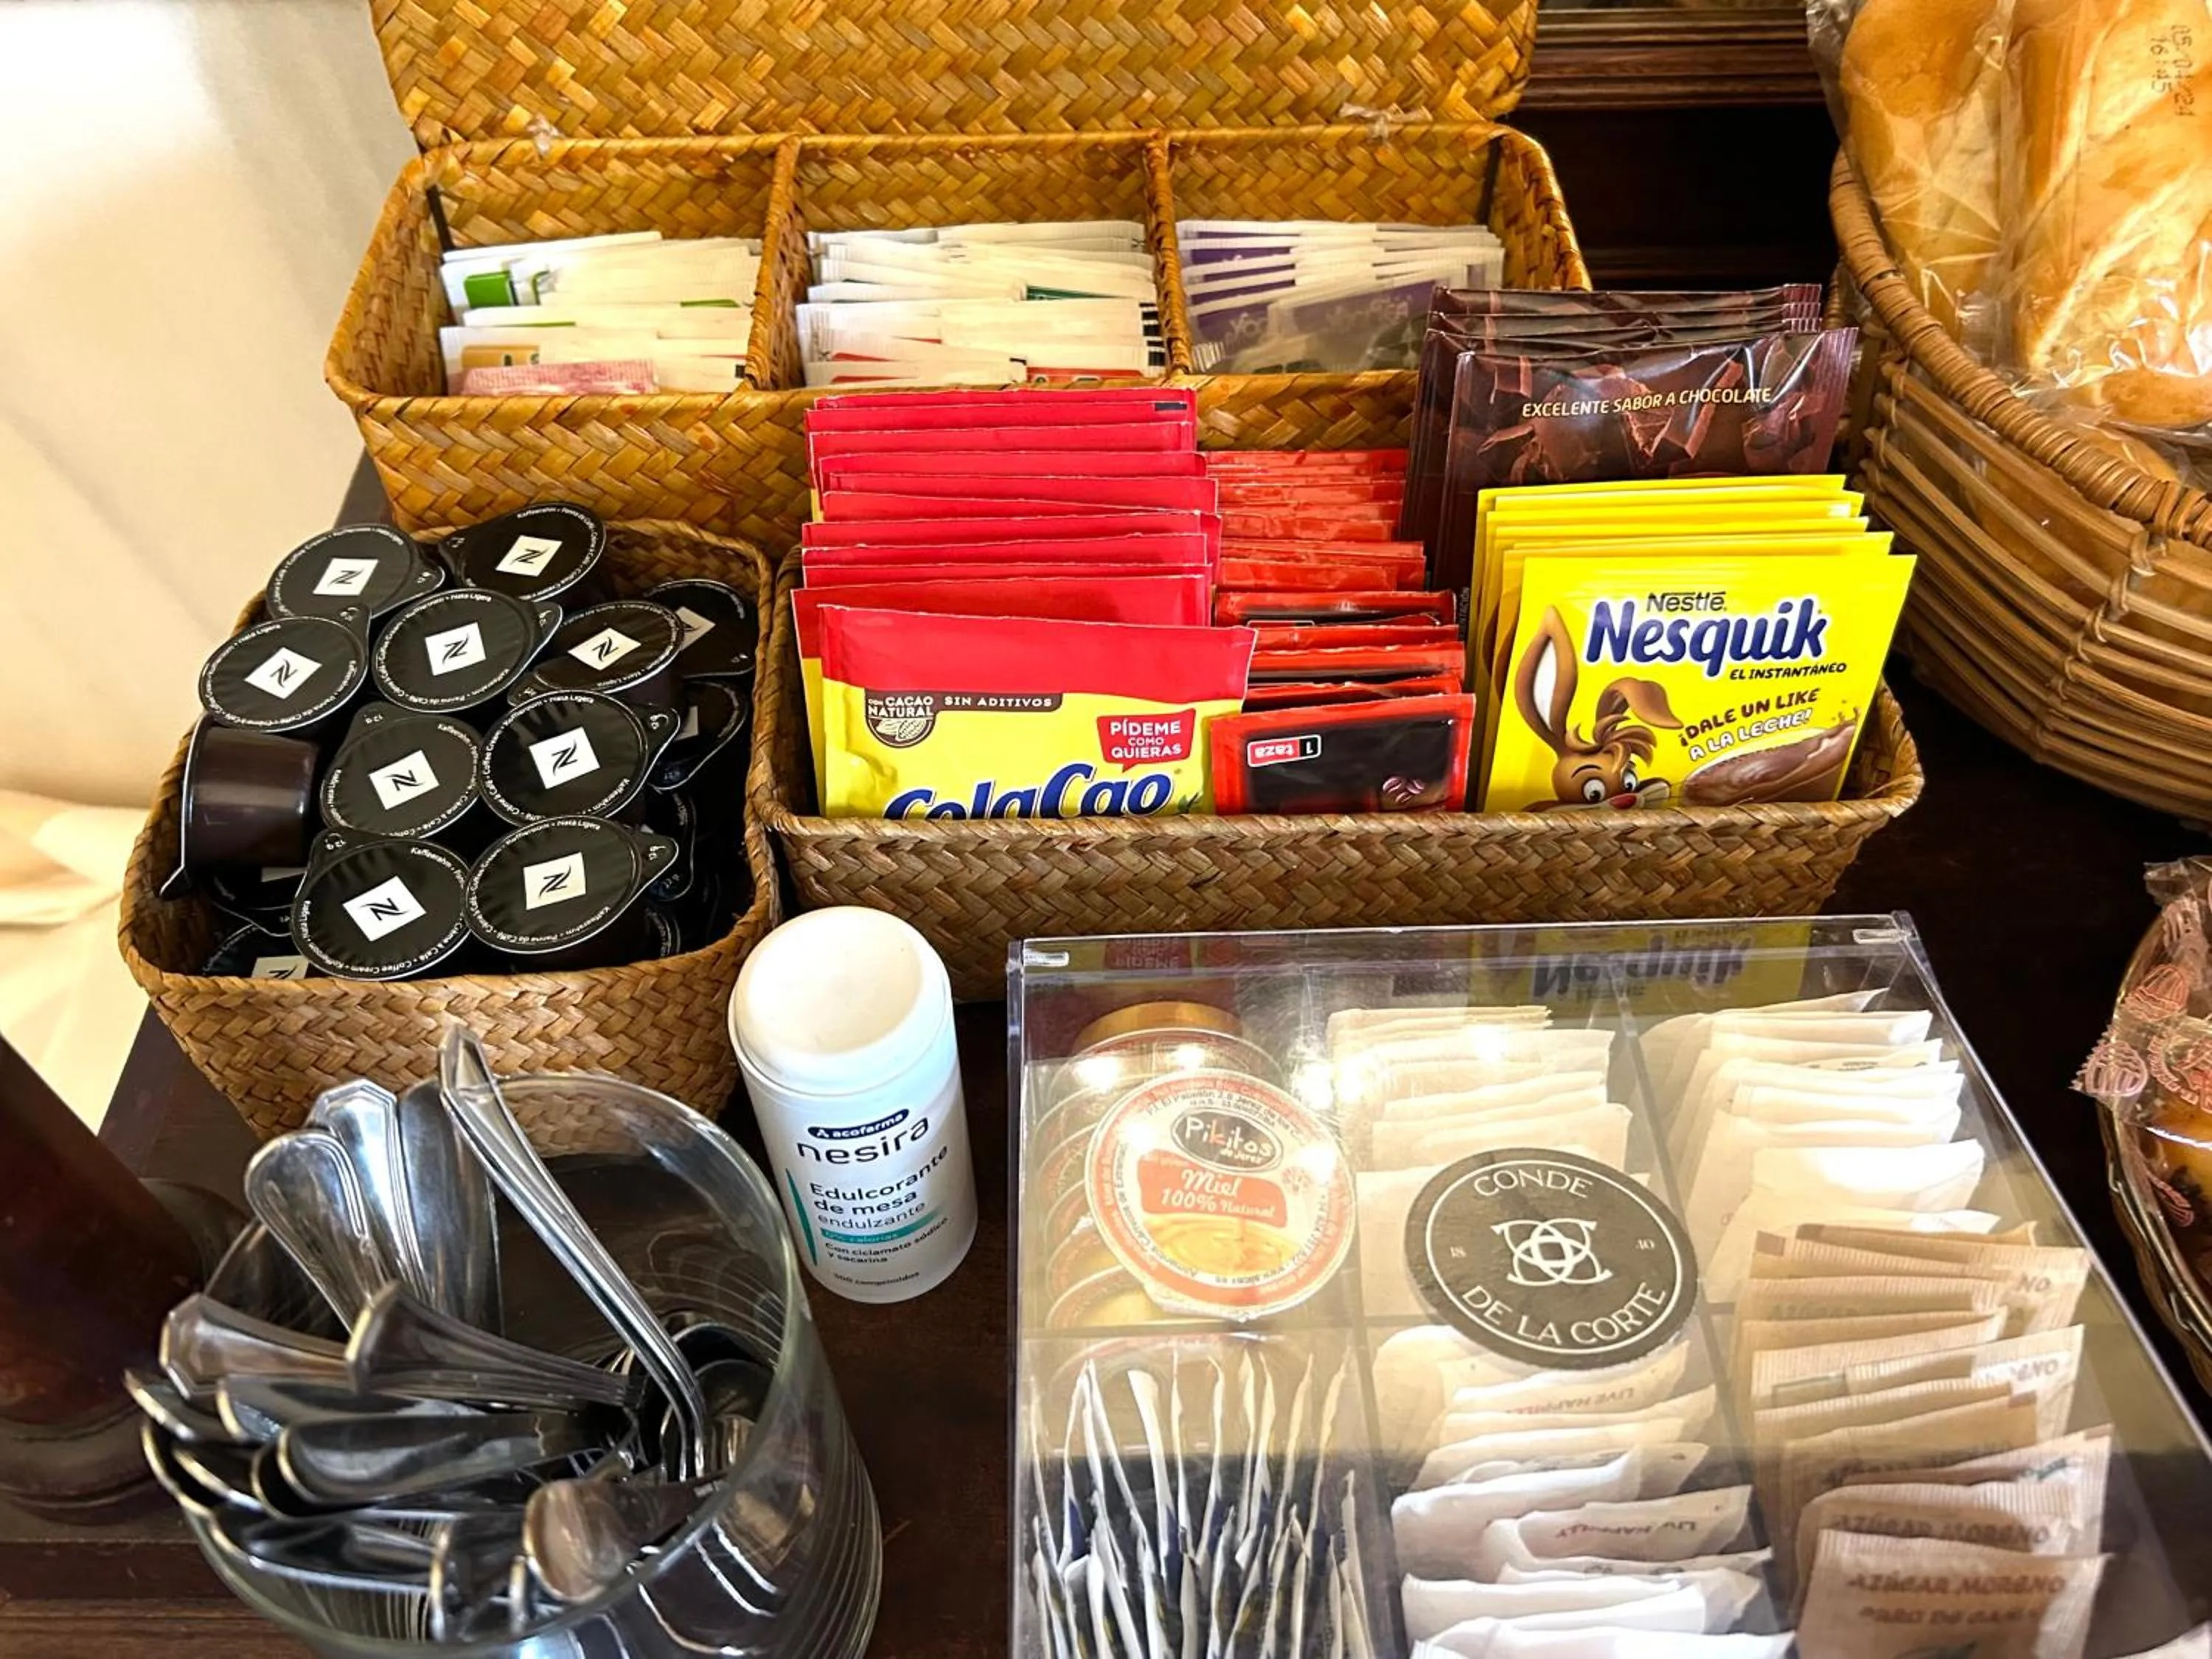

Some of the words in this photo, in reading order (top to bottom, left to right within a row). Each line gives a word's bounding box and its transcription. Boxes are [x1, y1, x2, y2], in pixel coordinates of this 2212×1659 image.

[1522, 400, 1610, 417] EXCELENTE
[1613, 394, 1662, 414] SABOR
[1665, 392, 1677, 406] A
[1678, 388, 1771, 406] CHOCOLATE
[1646, 591, 1727, 613] Nestlé
[1586, 598, 1828, 678] Nesquik
[1730, 669, 1747, 681] EL
[1748, 661, 1847, 680] INSTANTÁNEO
[868, 706, 934, 717] NATURAL
[886, 696, 933, 706] CACAO
[944, 696, 971, 706] SIN
[978, 697, 1053, 708] ADITIVOS
[1110, 717, 1181, 736] PÍDEME
[1677, 709, 1737, 747] ¡DALE
[1741, 698, 1770, 718] UN
[1775, 688, 1821, 710] LIKE
[1127, 737, 1164, 747] COMO
[1688, 745, 1705, 762] A
[1707, 732, 1735, 754] LA
[1737, 709, 1813, 742] LECHE!
[1110, 744, 1183, 759] QUIERAS
[1254, 742, 1297, 759] taza
[832, 1112, 904, 1138] acofarma
[1184, 1115, 1273, 1158] Pikitos
[796, 1116, 929, 1165] nesira
[810, 1145, 948, 1201] Edulcorante
[1180, 1169, 1242, 1197] Miel
[1472, 1167, 1594, 1200] CONDE
[813, 1197, 844, 1215] de
[851, 1190, 918, 1217] mesa
[1161, 1187, 1217, 1212] 100%
[817, 1201, 926, 1231] endulzante
[1461, 1284, 1514, 1326] DE
[1517, 1314, 1564, 1346] LA
[1570, 1281, 1668, 1346] CORTE
